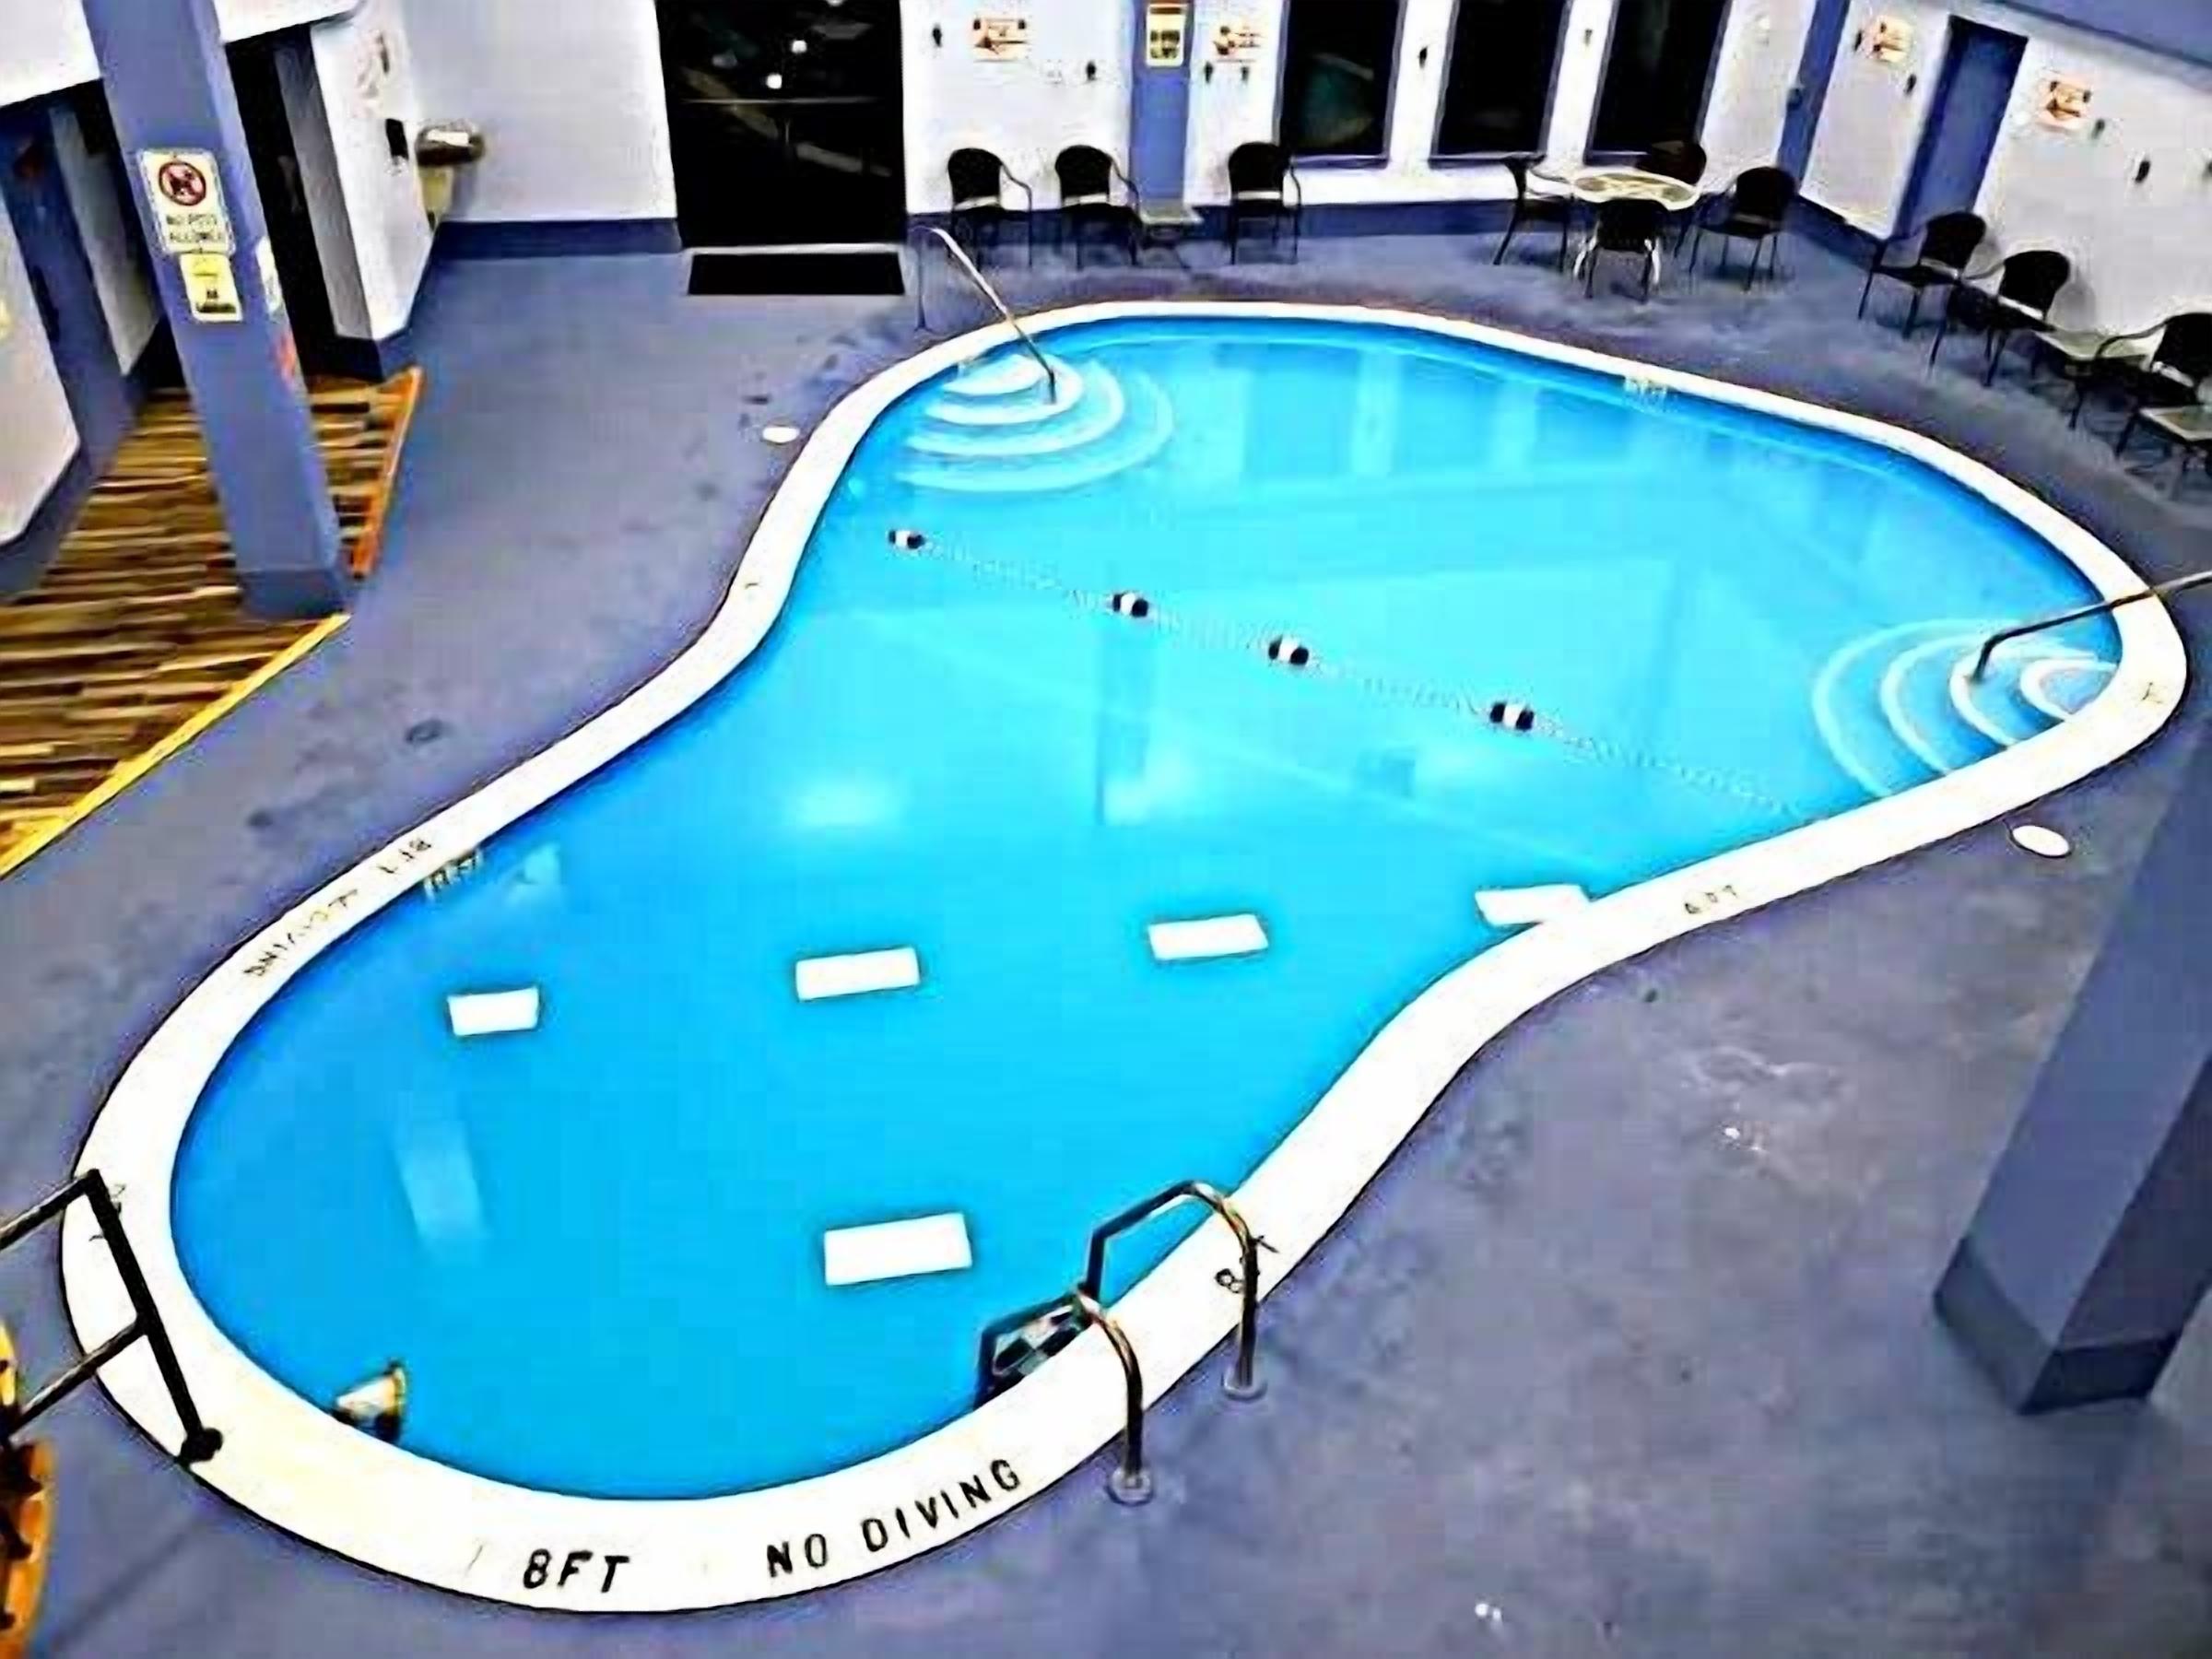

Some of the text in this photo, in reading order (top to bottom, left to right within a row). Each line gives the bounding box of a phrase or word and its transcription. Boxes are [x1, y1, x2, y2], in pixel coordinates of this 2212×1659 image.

[523, 1459, 1020, 1593] 8FT NO DIVING
